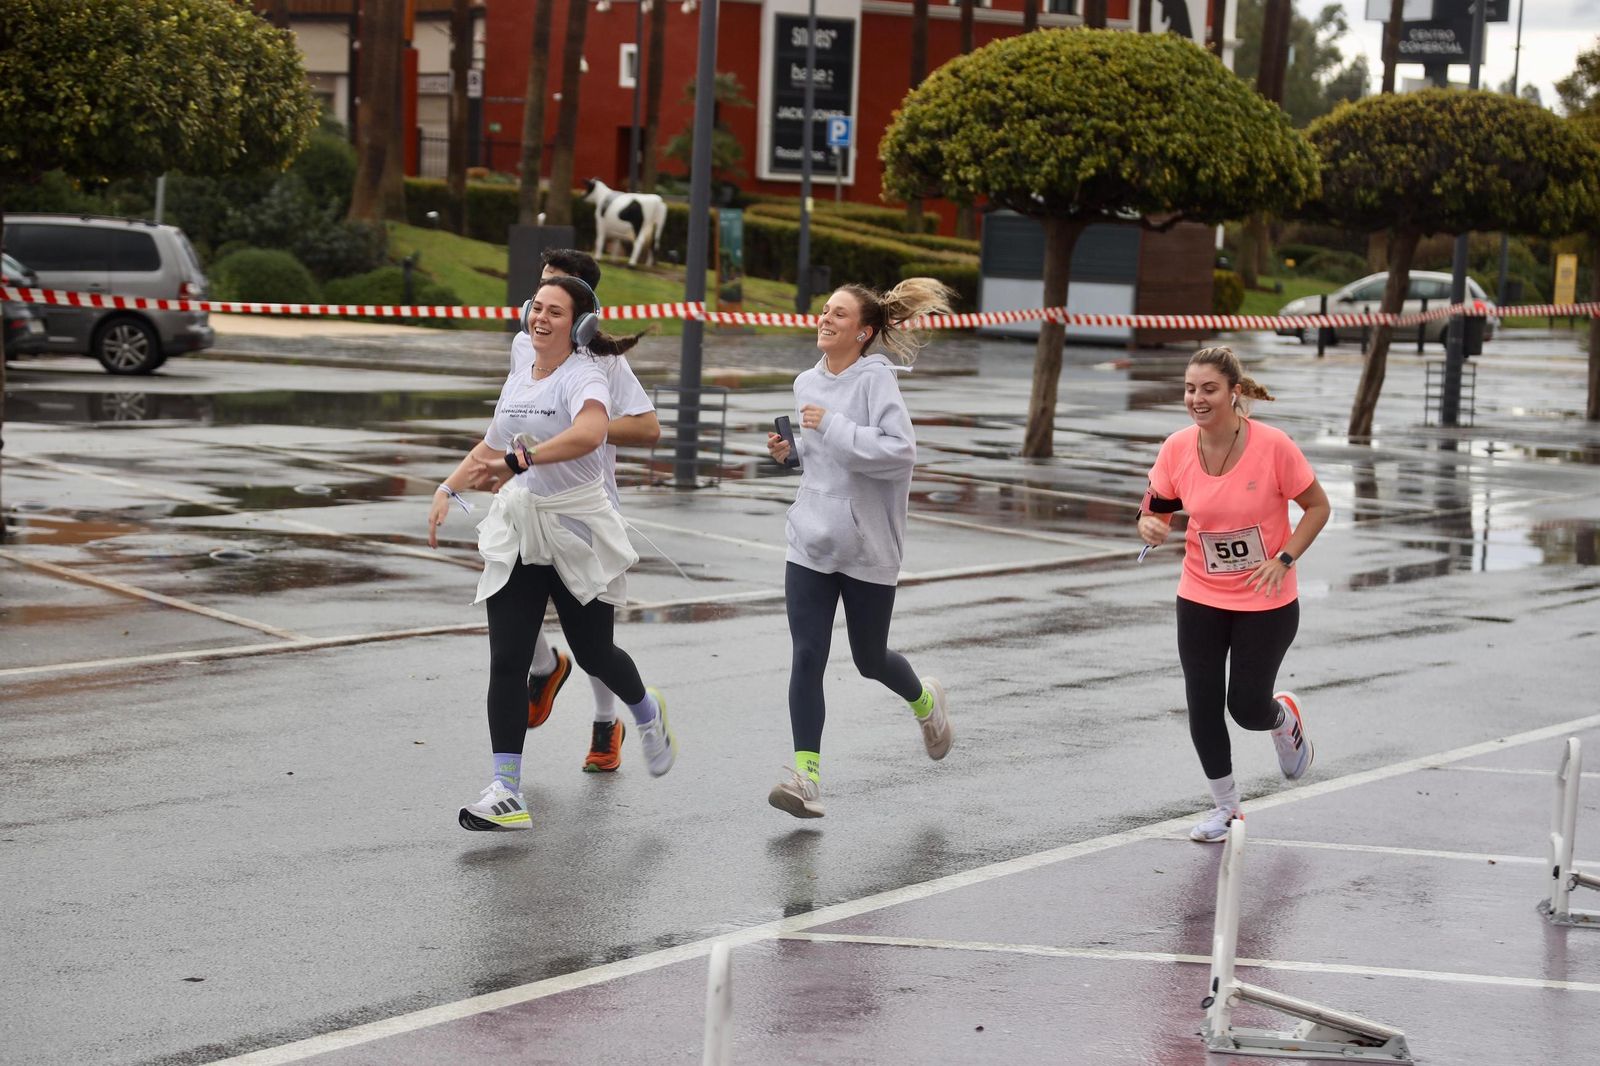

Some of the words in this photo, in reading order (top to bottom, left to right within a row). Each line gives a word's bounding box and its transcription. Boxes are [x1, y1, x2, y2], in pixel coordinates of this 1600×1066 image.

[1409, 28, 1456, 41] CENTRO
[1398, 40, 1464, 54] COMERCIAL
[830, 119, 848, 142] P
[1214, 540, 1249, 559] 50
